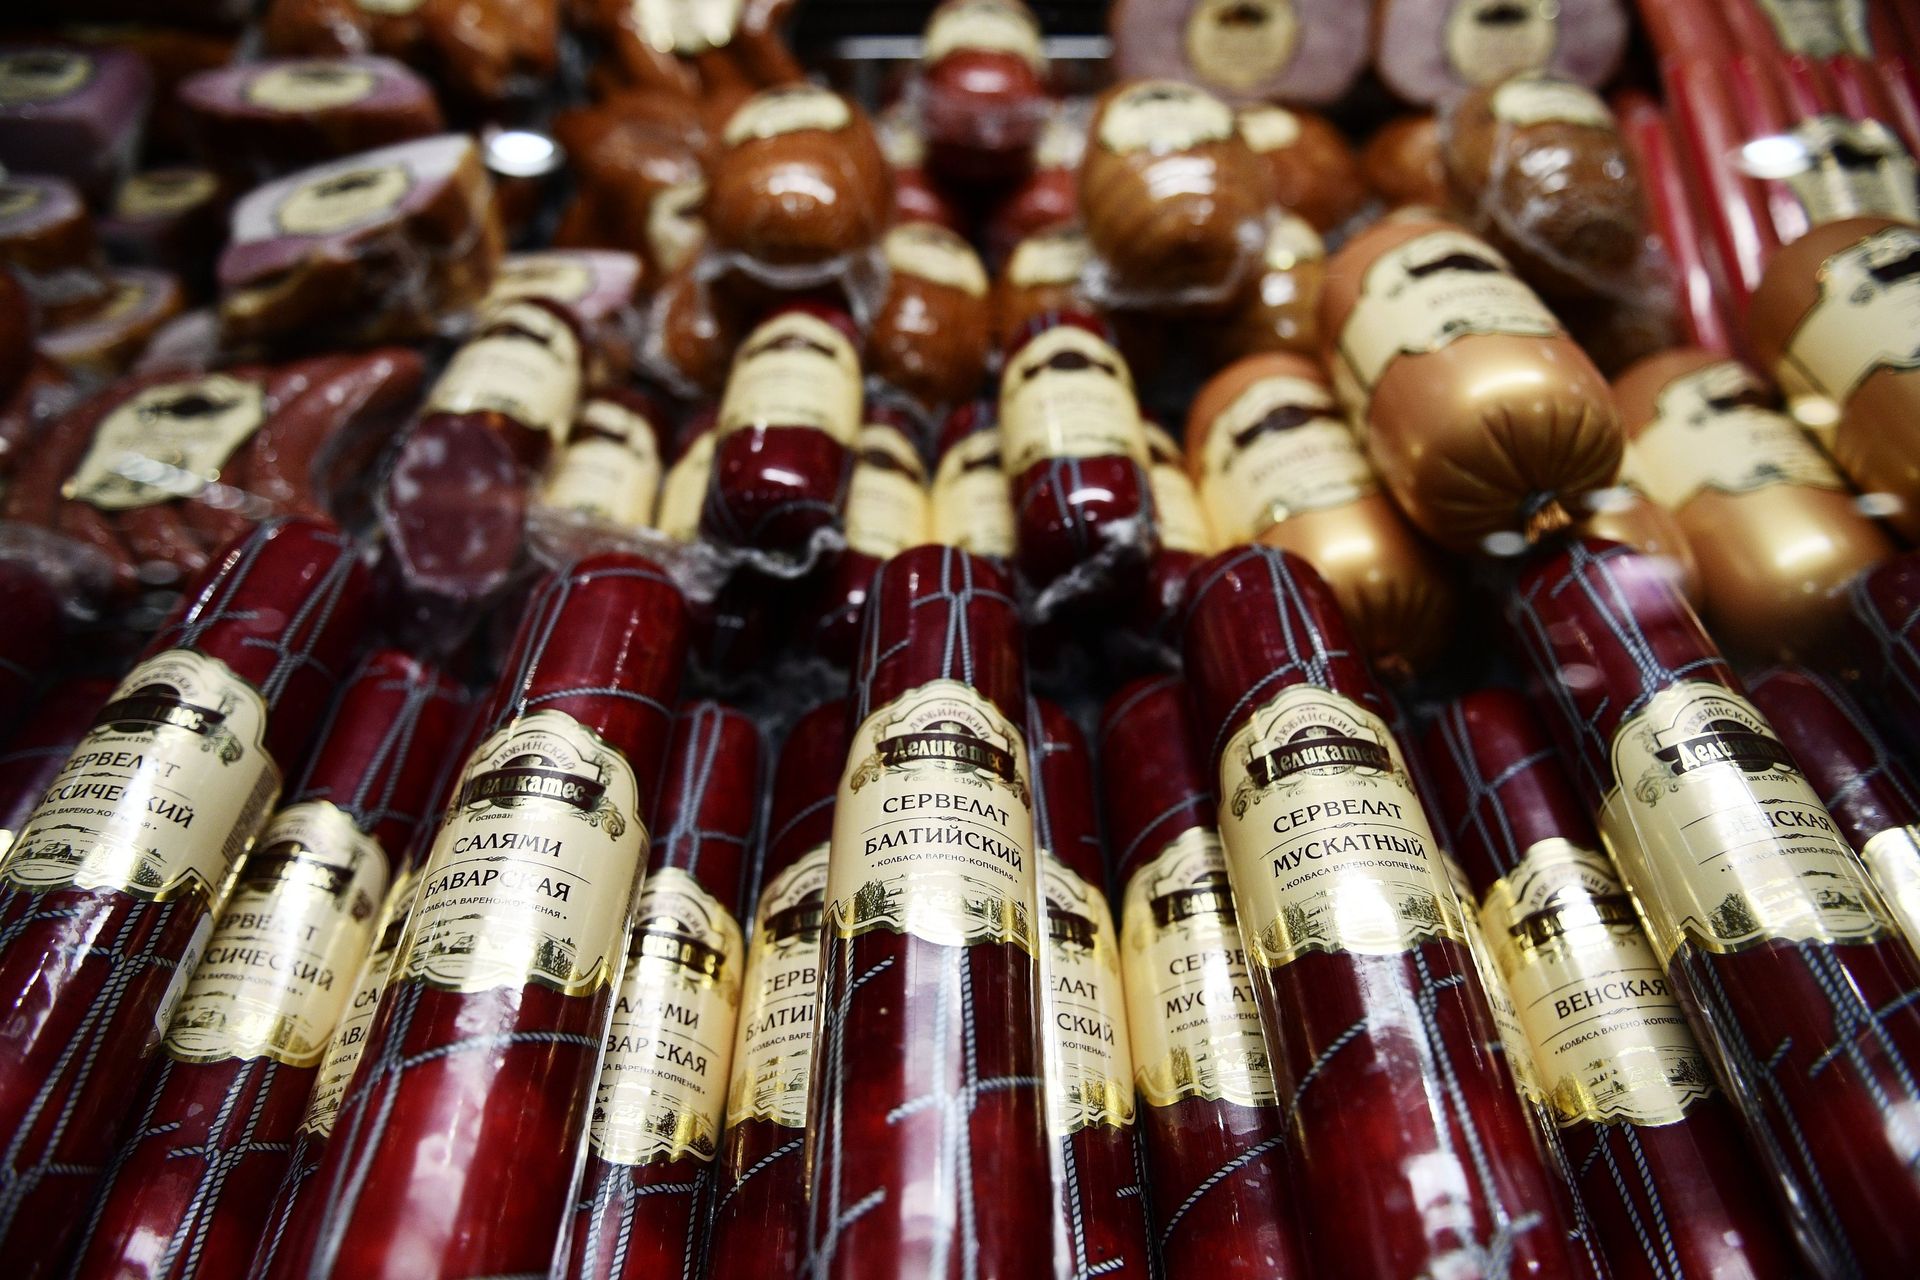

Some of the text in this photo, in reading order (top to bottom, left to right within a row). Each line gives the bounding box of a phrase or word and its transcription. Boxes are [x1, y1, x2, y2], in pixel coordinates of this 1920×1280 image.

[60, 751, 181, 778] СЕРВЕЛТ
[882, 792, 1010, 827] СЕРВЕЛАТ
[1273, 799, 1403, 833] СЕРВЕЛАТ
[453, 832, 563, 858] САЛЯМИ
[864, 824, 1023, 873] БАЛТИЙСКИЙ
[1273, 833, 1428, 878] МУСКАТНЫЙ
[877, 853, 1015, 883] КОЛБАСА ВАРЕНО-КОПЧЕНАЯ
[1286, 868, 1331, 890] КОЛБАСА
[424, 869, 572, 902] БАВАРСКАЯ
[459, 896, 561, 919] ВАРЕНО-КОЕНАЯ
[614, 996, 699, 1030] АЛМИ
[1554, 979, 1670, 1021] ВЕНСКАЯ
[1056, 1012, 1115, 1047] СКИЙ
[1559, 1029, 1600, 1054] КОЛБАСА
